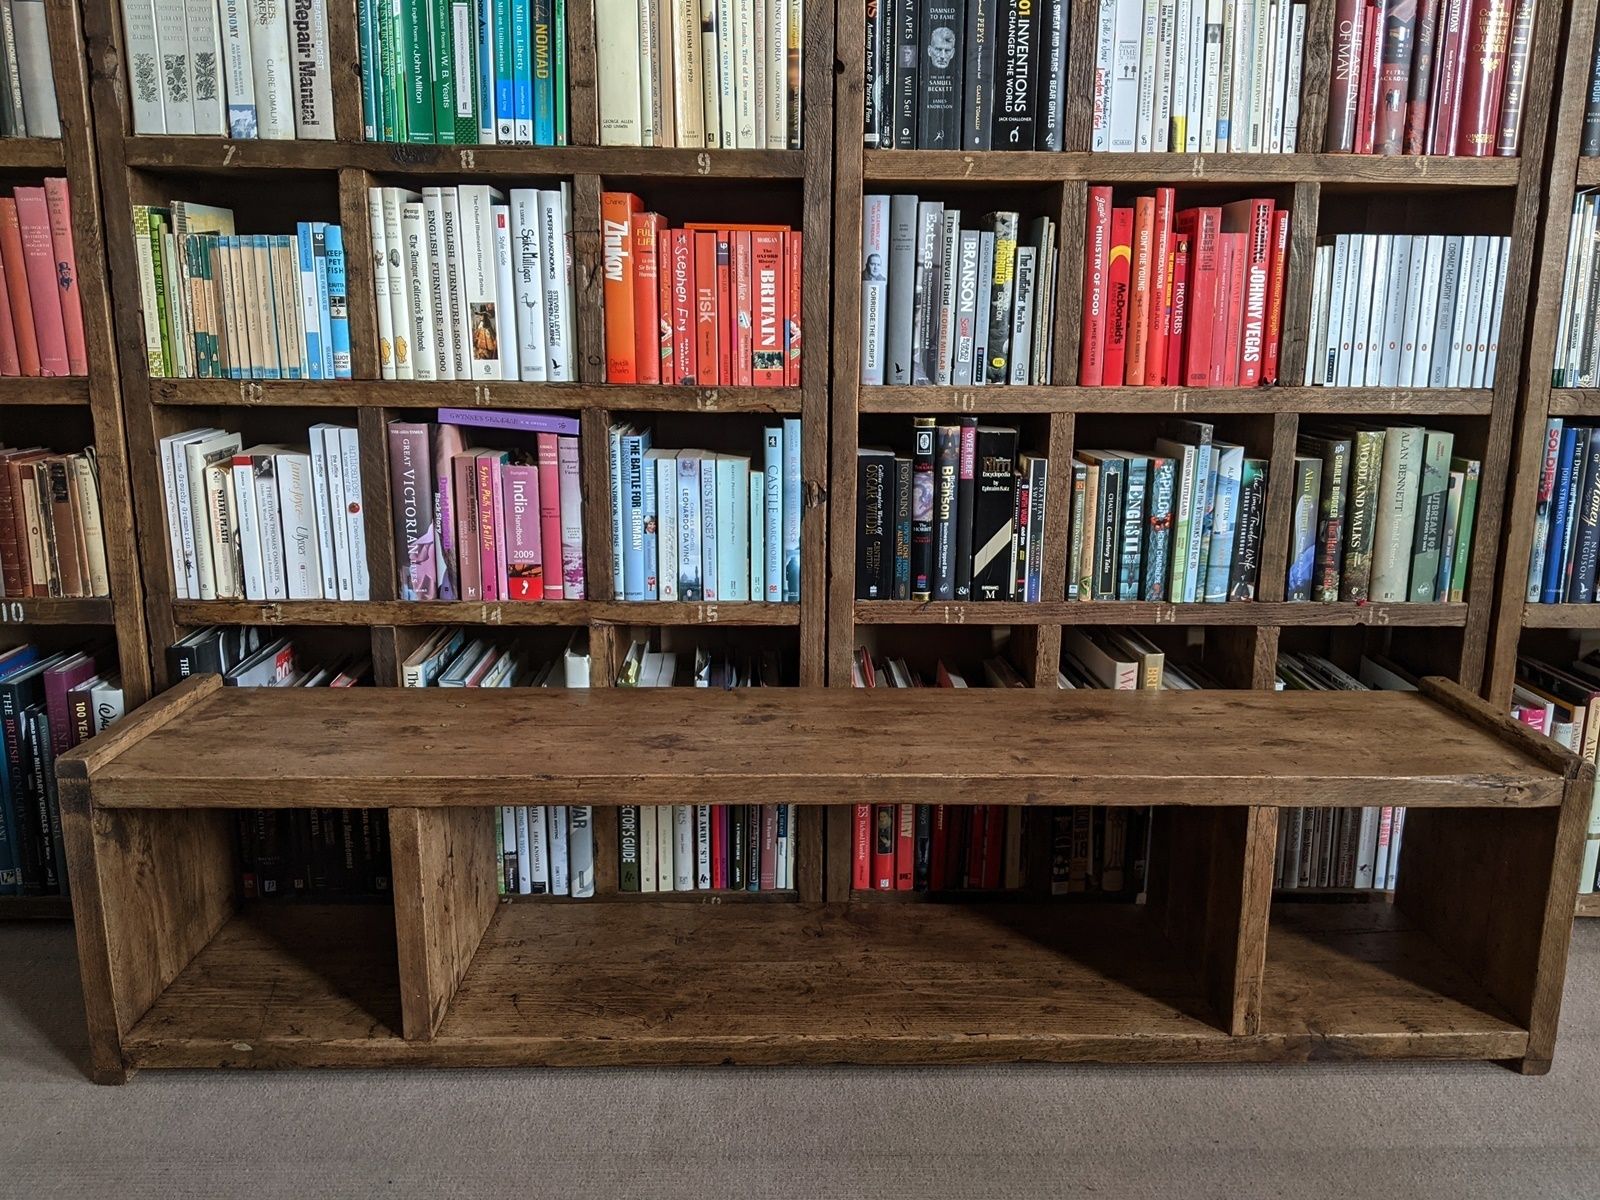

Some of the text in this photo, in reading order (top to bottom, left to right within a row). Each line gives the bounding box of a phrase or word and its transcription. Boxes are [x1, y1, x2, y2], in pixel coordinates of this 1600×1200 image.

[516, 26, 522, 35] on
[905, 15, 913, 39] APES
[976, 18, 984, 43] PEPYS
[1007, 10, 1016, 55] CHANGED
[1051, 5, 1060, 72] SWEAT AND TEARS
[1164, 40, 1172, 57] WHO
[293, 0, 319, 126] Repair Manual
[516, 40, 524, 70] Liberty
[536, 24, 548, 78] NOMAD
[1014, 19, 1029, 112] INVENTIONS
[1163, 58, 1171, 83] STARE
[1336, 20, 1352, 80] OF MAN
[266, 59, 277, 124] CLAIRE TOMALIN
[413, 50, 423, 103] John Milton
[441, 56, 450, 108] W. B. Yeats
[1005, 79, 1013, 112] WORLD
[1163, 85, 1169, 94] AT
[903, 99, 911, 117] Self
[1048, 80, 1057, 128] BEAR GRYLLS
[223, 144, 236, 167] 7
[460, 150, 475, 169] 8
[698, 152, 711, 175] 9
[964, 156, 974, 178] 7
[1192, 156, 1205, 178] 8
[1415, 156, 1429, 177] 9
[152, 238, 160, 254] BEE
[547, 208, 555, 279] SUPERFREAKONOMICS
[924, 213, 937, 269] Extras
[946, 216, 954, 233] The
[516, 228, 538, 283] Spike Milligan
[604, 220, 629, 281] Zhukov
[944, 237, 954, 281] Bruneval
[995, 240, 1006, 284] OVERRULED
[1092, 226, 1103, 315] MINISTRY OF FOOD
[1137, 231, 1148, 291] DON'T DIE YOUNG
[155, 274, 163, 296] BORN
[409, 234, 426, 352] The Antique Collector's Handbook
[428, 210, 446, 372] ENGLISH FURNITURE: 1760-1900
[445, 211, 463, 372] ENGLISH FURNITURE: 1550-1760
[675, 247, 688, 331] Stephen Fry
[943, 284, 951, 305] Raid
[960, 242, 975, 312] BRANSON
[1018, 254, 1032, 303] The Godfather
[1439, 243, 1456, 330] CORMAC McCARTHY THE ROAD
[699, 289, 715, 323] risk
[760, 270, 775, 346] BRITAIN
[1114, 282, 1126, 344] McDonald's
[1174, 282, 1185, 335] PROVERBS
[1244, 266, 1265, 362] JOHNNY VEGAS
[868, 339, 876, 368] SCRIPTS
[240, 382, 262, 404] 10
[475, 385, 490, 405] 11
[697, 390, 718, 410] 12
[1174, 392, 1187, 411] 11
[403, 438, 411, 466] GREAT
[513, 480, 527, 513] India
[630, 440, 641, 551] THE BATTLE FOR GERMANY
[767, 465, 778, 513] CASTLE
[865, 464, 877, 535] OSCAR WILDE
[899, 462, 909, 516] TOBY YOUNG
[940, 466, 953, 520] Branson
[1036, 477, 1044, 520] JONATHAN
[1157, 465, 1172, 518] PAPILLON
[1330, 455, 1343, 518] CHARLIE BROOKER
[1351, 442, 1370, 548] WOODLAND WALKS
[1388, 432, 1410, 568] ALAN BENNETT Untold Stories
[1556, 467, 1569, 524] JOHN STRAWSON
[217, 489, 229, 544] SYLVIA PLATH
[403, 469, 418, 554] VICTORIAN
[682, 489, 690, 530] LEONARDO
[683, 533, 689, 543] DA
[1104, 526, 1112, 556] Canterbury
[1579, 530, 1597, 580] NIALL FERGUSON
[1, 602, 24, 623] 10
[482, 605, 501, 624] 14
[698, 605, 718, 622] 15
[1156, 605, 1176, 624] 14
[1369, 606, 1389, 624] 15
[180, 658, 190, 676] THE
[2, 692, 19, 764] THE BRITISH
[75, 701, 85, 718] 100
[34, 757, 49, 833] MILITARY VEHICLES
[900, 805, 912, 838] DIARY
[622, 838, 635, 863] GUIDE
